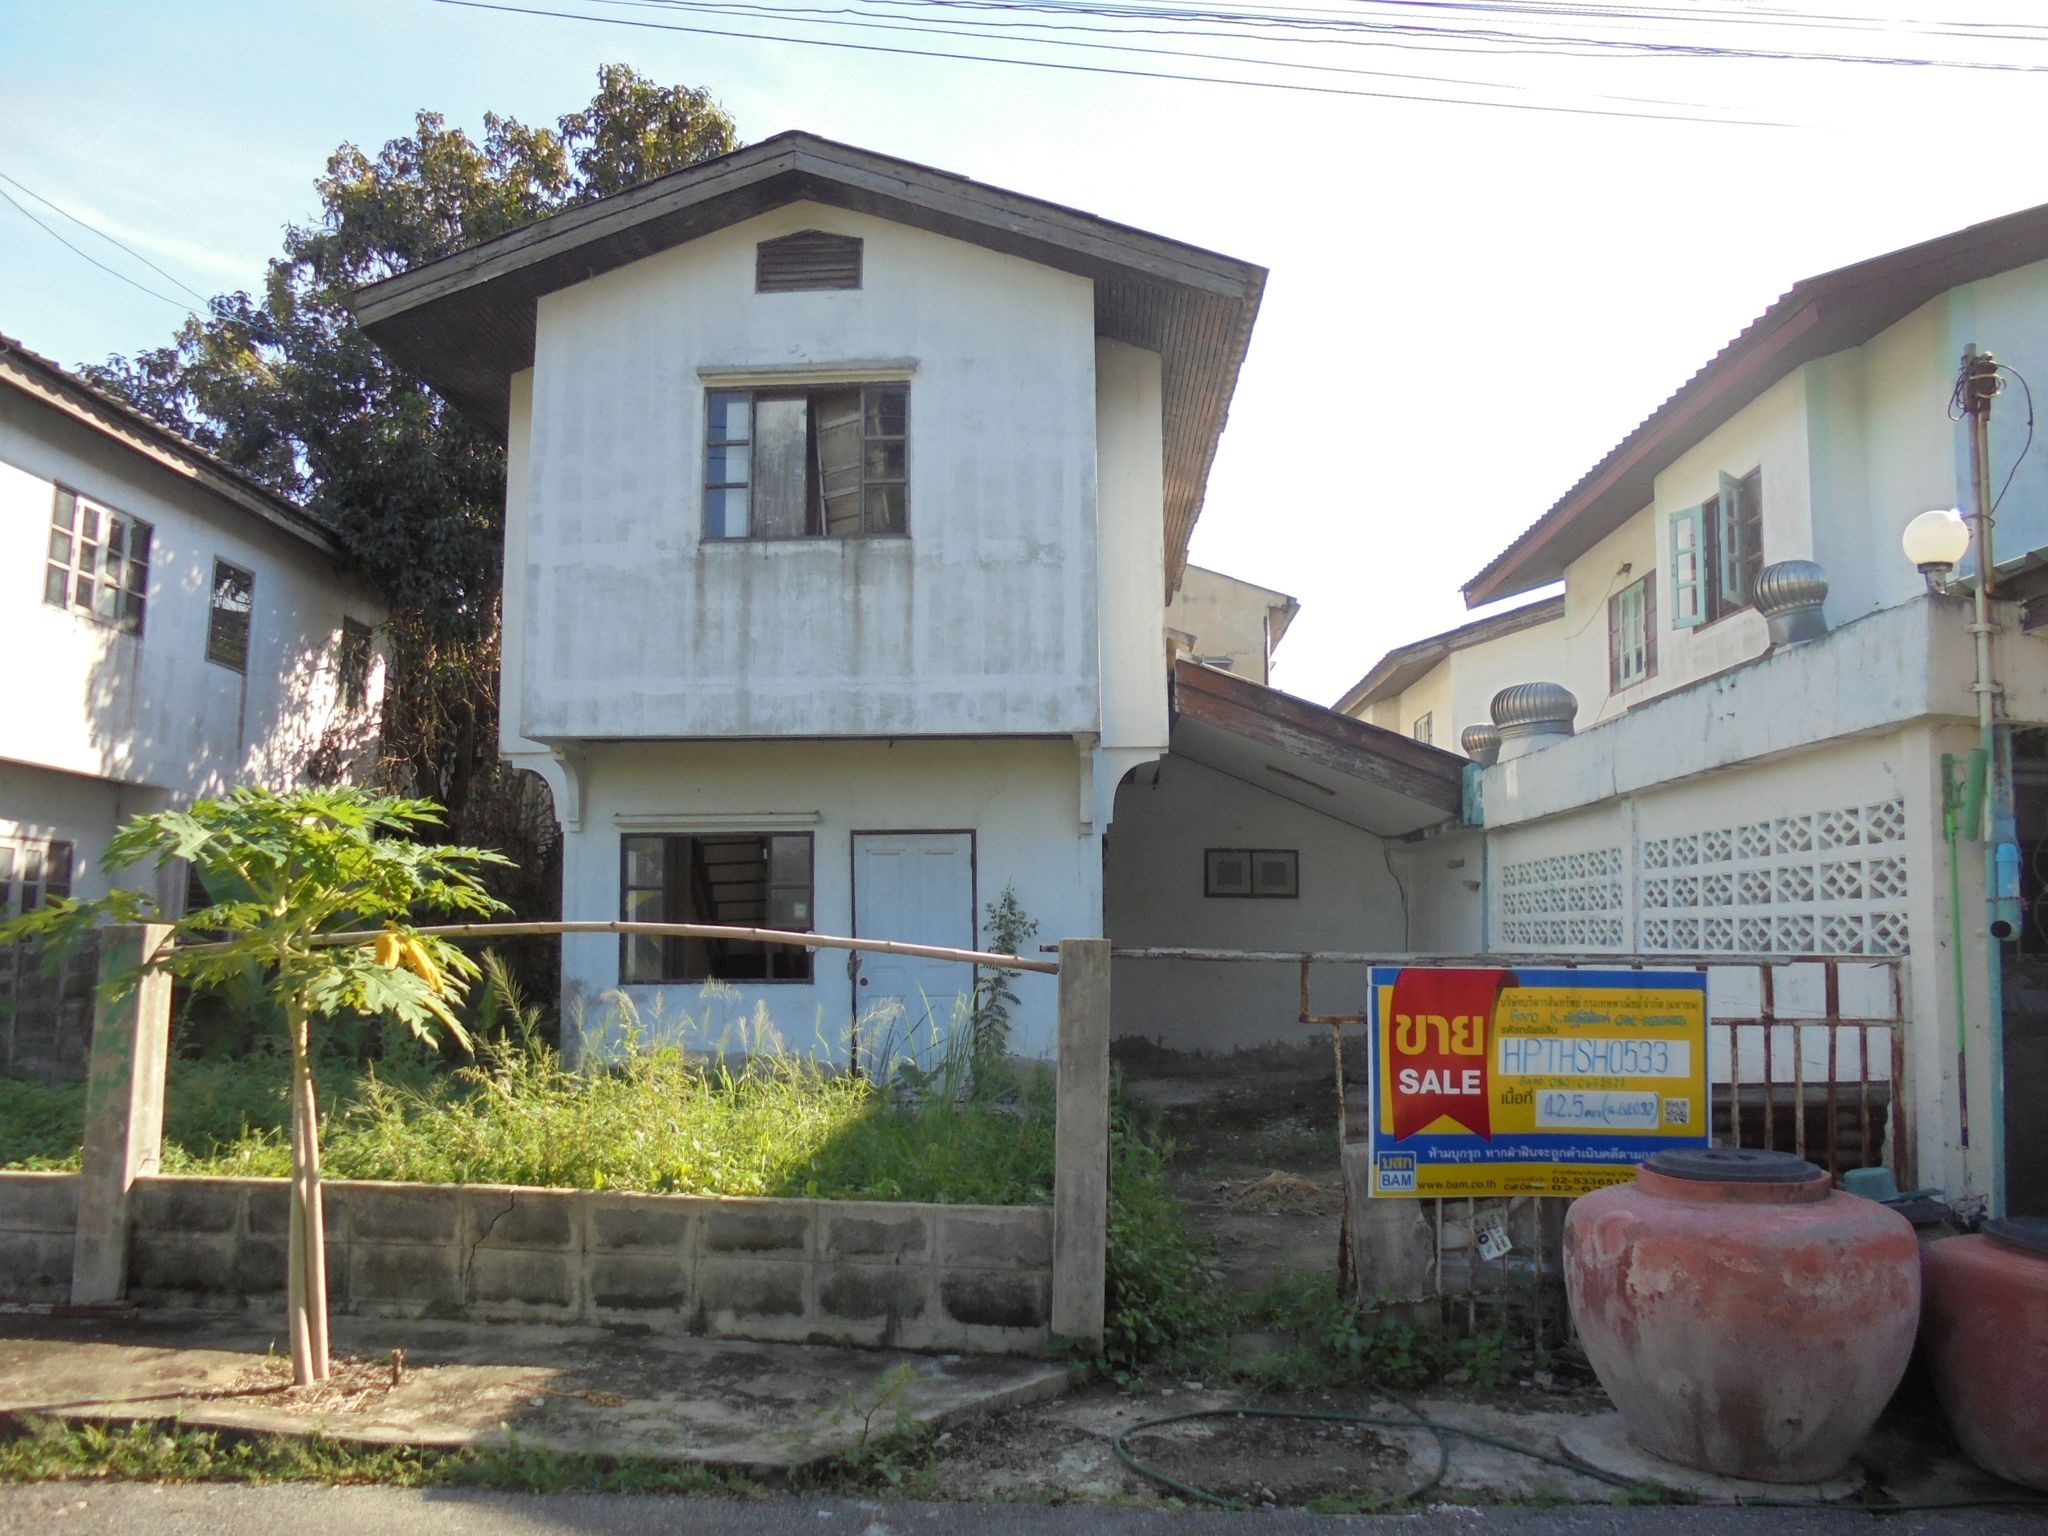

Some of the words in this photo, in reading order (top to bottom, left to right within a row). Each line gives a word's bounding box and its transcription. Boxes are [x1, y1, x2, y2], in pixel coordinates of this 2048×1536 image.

[1396, 1014, 1483, 1056] ขาย
[1504, 1038, 1669, 1074] HPTHSH0533
[1399, 1068, 1481, 1095] SALE
[1501, 1087, 1533, 1105] เนื้อที่
[1428, 1146, 1480, 1163] ห้ามบุกรุก
[1382, 1174, 1412, 1187] BAM
[1417, 1179, 1497, 1190] www.bam.co.th
